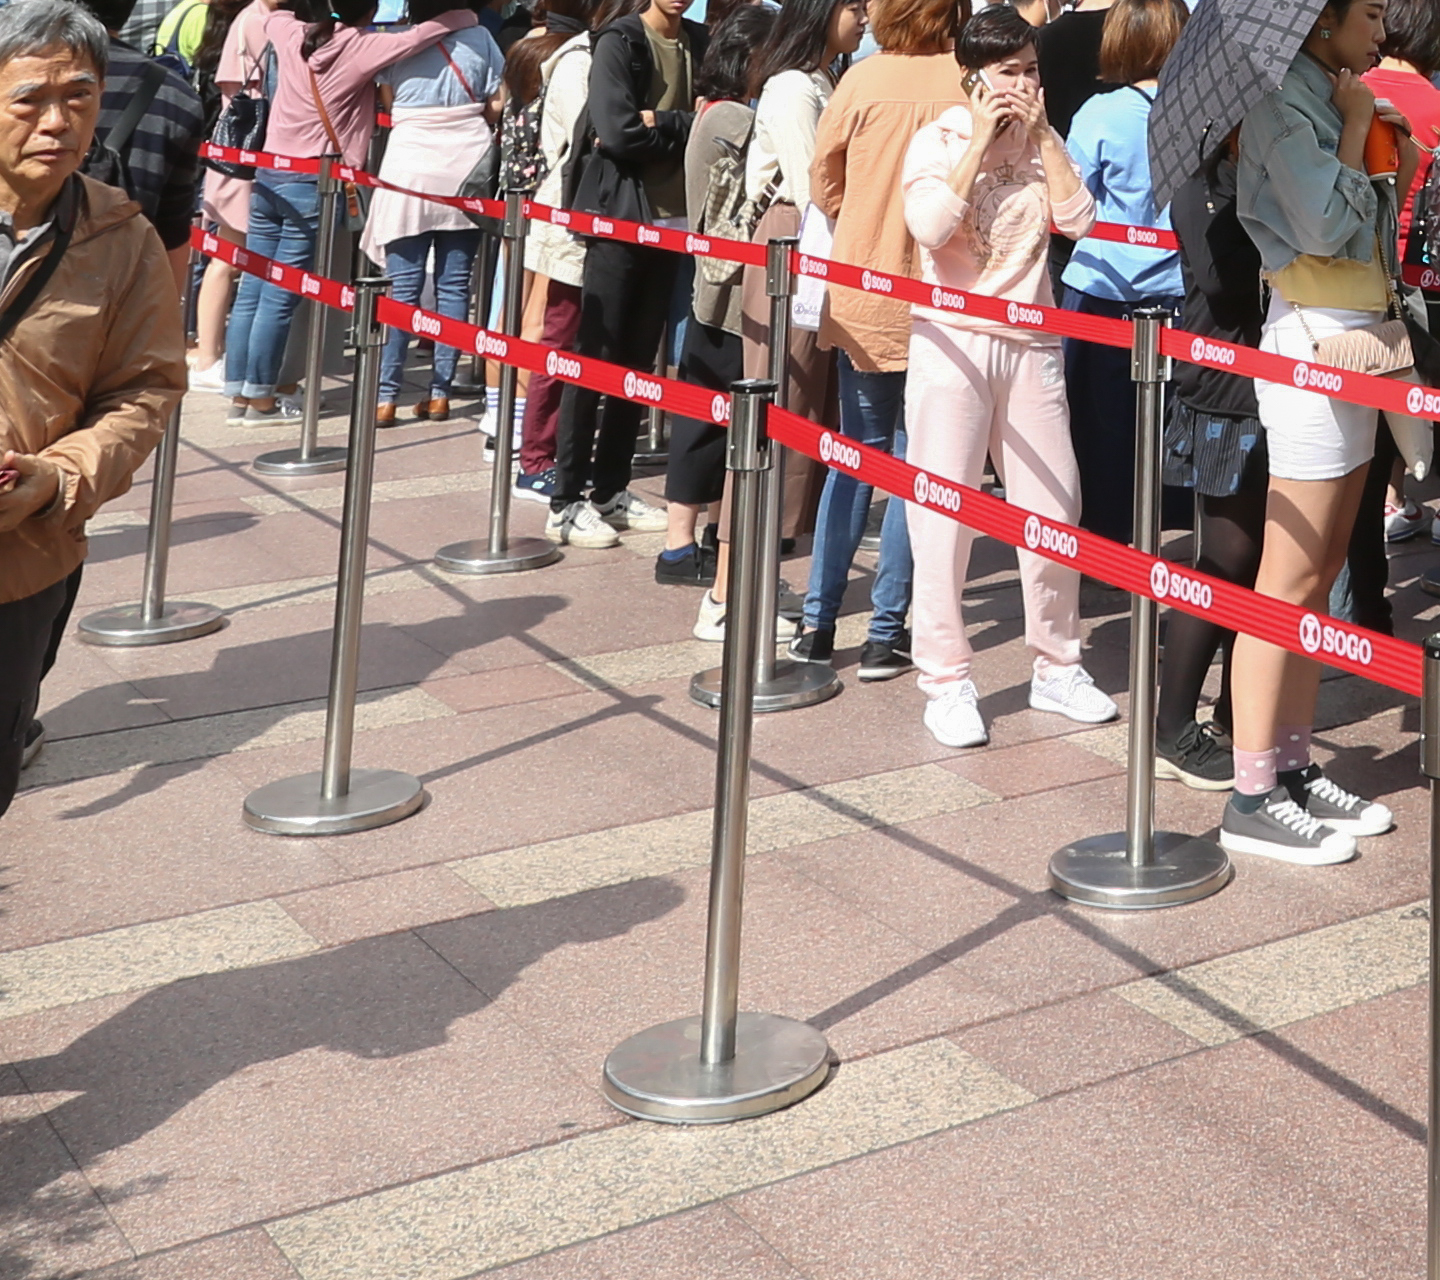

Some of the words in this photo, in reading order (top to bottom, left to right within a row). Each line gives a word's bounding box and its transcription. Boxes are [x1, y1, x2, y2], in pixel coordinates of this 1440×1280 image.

[644, 230, 659, 243] SOGO
[1137, 227, 1157, 244] SOGO
[694, 239, 710, 253] SOGO
[809, 261, 828, 276] SOGO
[872, 276, 892, 292] SOGO
[943, 292, 965, 309] SOGO
[1020, 306, 1043, 324] SOGO
[424, 317, 441, 337] SOGO
[486, 337, 507, 357] SOGO
[1204, 343, 1235, 365] SOGO
[557, 358, 581, 379] SOGO
[635, 377, 662, 401] SOGO
[1308, 370, 1343, 393] SOGO
[833, 441, 860, 470] SOGO
[929, 480, 960, 512] SOGO
[1041, 523, 1077, 558] SOGO
[1170, 573, 1212, 608] SOGO
[1322, 625, 1372, 666] SOGO
